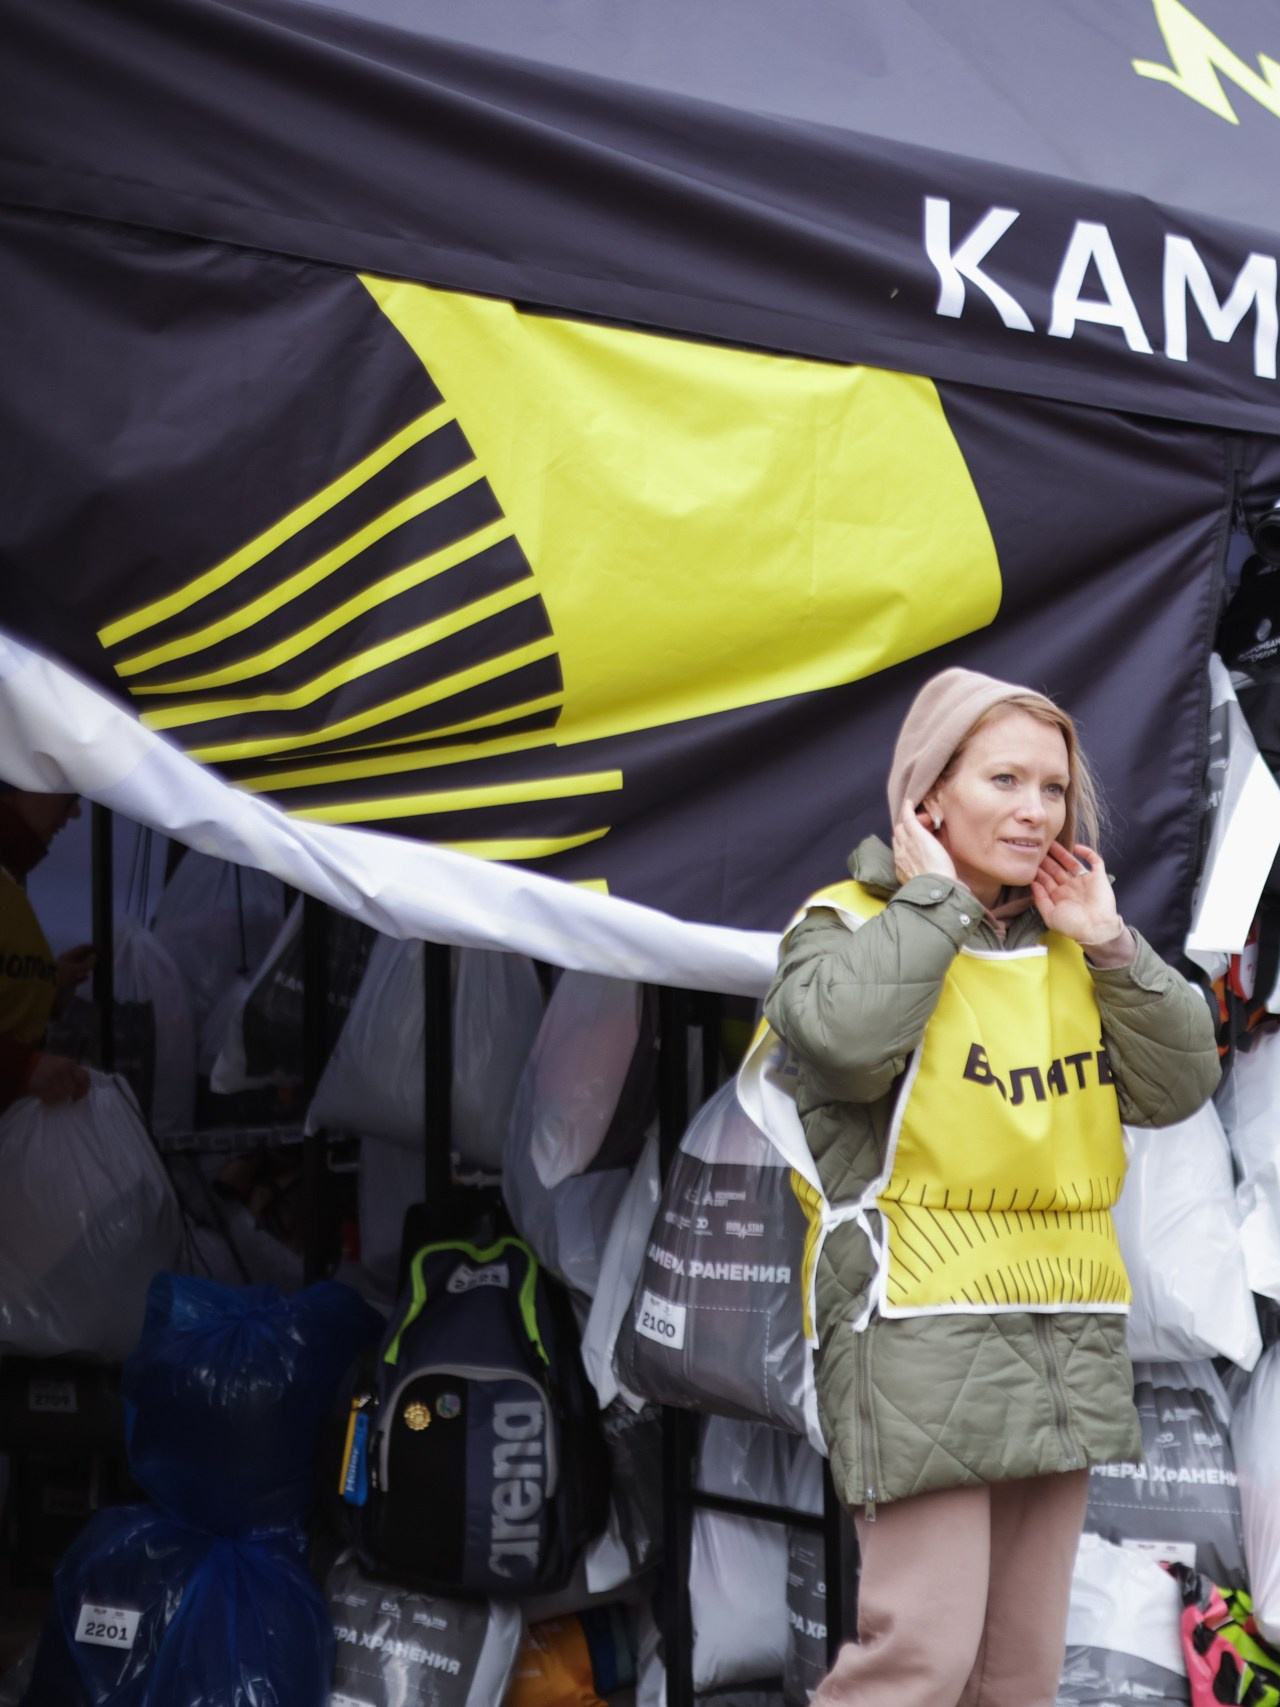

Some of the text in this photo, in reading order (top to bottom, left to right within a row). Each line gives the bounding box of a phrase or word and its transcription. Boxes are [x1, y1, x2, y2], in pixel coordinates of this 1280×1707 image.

[688, 1260, 792, 1285] РАНЕНИЯ
[642, 1311, 676, 1339] 2100
[84, 1621, 128, 1641] 2201
[358, 1631, 462, 1676] ХРАНЕНИЯ
